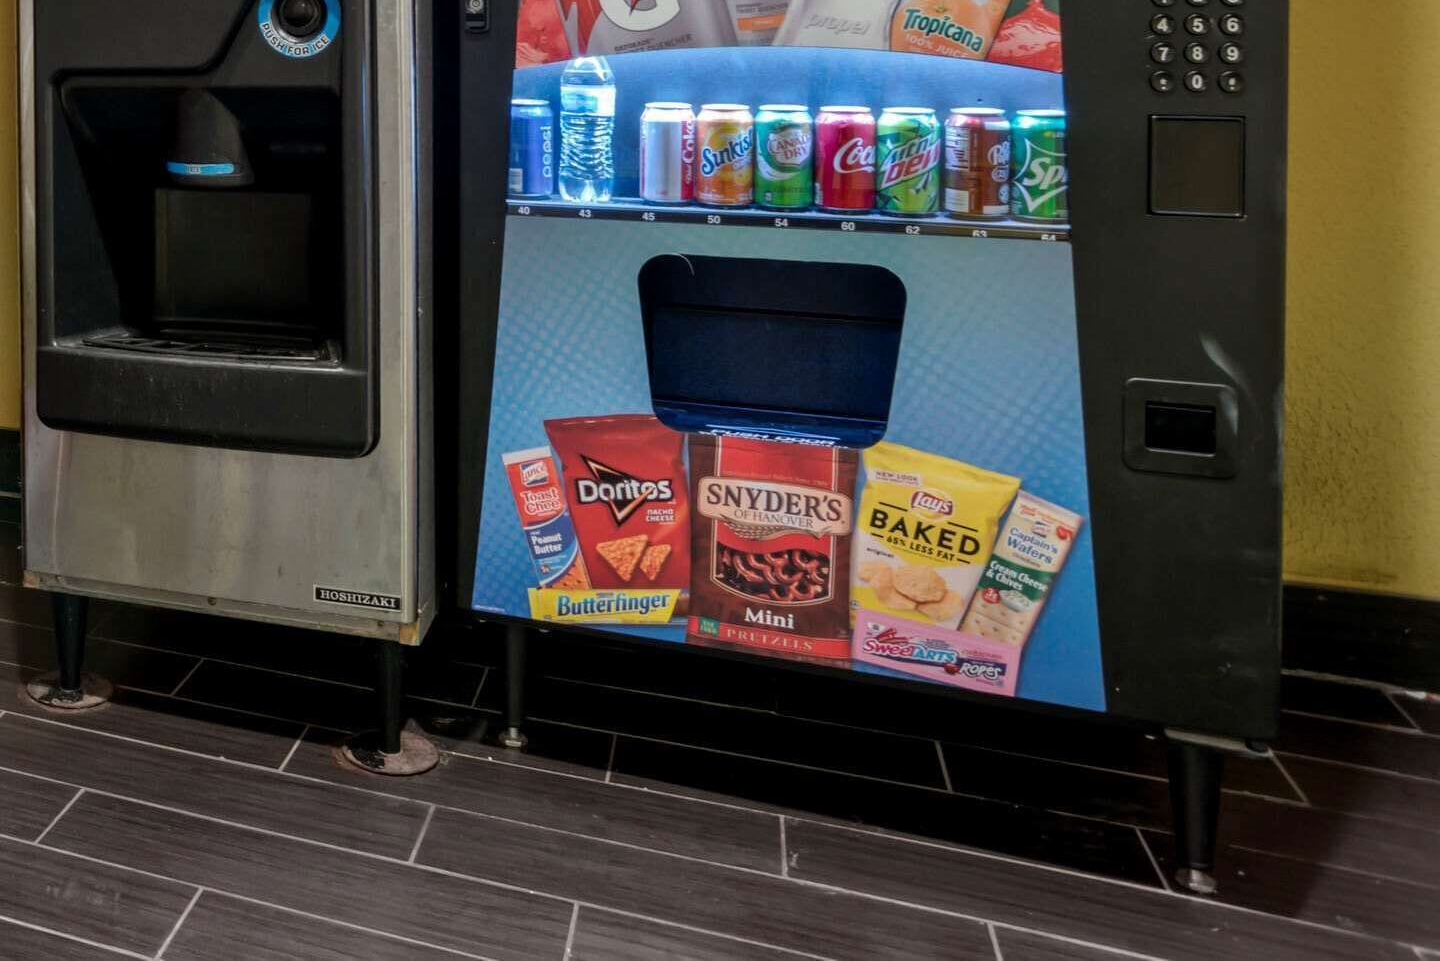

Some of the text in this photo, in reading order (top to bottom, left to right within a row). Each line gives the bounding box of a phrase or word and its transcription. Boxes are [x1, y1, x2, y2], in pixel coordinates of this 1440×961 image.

[903, 8, 984, 53] Tropicana
[1156, 18, 1239, 32] 4 5 6
[262, 23, 329, 56] PUSH FOR ICE
[1159, 47, 1239, 60] 7 8 9
[1191, 74, 1203, 88] 0
[540, 125, 552, 178] pepsi
[518, 206, 530, 215] 40
[578, 209, 592, 218] 43
[641, 212, 655, 221] 45
[707, 215, 721, 224] 50
[774, 218, 788, 227] 54
[841, 222, 855, 231] 60
[905, 225, 920, 235] 62
[521, 488, 559, 503] Toast
[578, 478, 672, 503] Doritos
[707, 483, 843, 522] SNYDER'S
[526, 499, 560, 514] Chee
[734, 509, 814, 529] OF HANOVER
[531, 533, 563, 545] Peanut
[870, 508, 980, 556] BAKED
[1009, 526, 1058, 554] Captain's
[534, 543, 563, 555] Butter
[886, 535, 955, 561] 65% LESS FAT
[1007, 537, 1054, 564] Wafers
[320, 589, 396, 608] HOSHIZAKI
[557, 592, 670, 617] Butterfinger
[744, 606, 795, 630] Mini
[727, 628, 813, 652] PRETZELS
